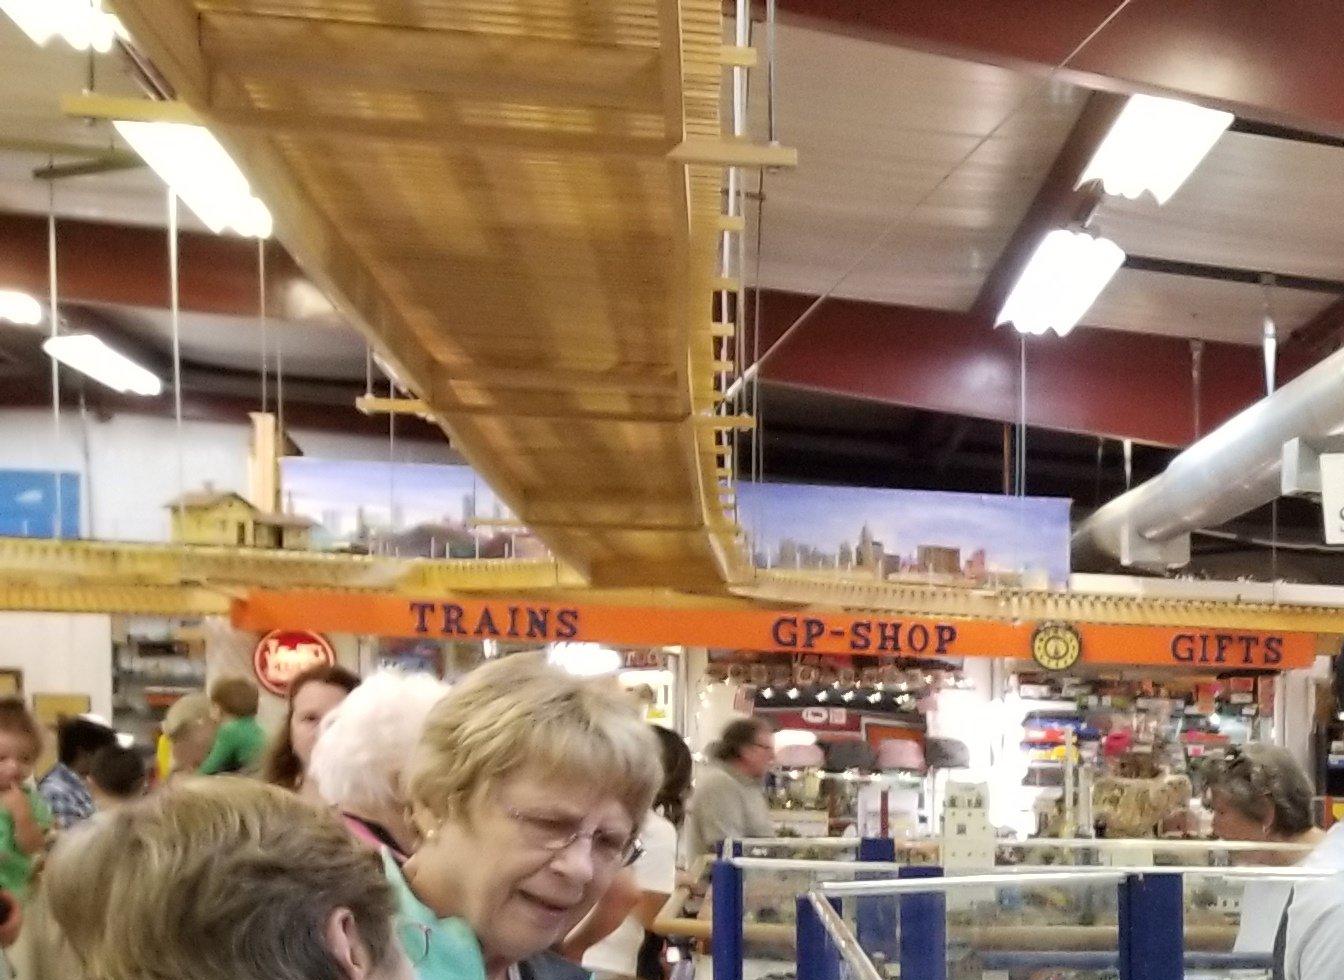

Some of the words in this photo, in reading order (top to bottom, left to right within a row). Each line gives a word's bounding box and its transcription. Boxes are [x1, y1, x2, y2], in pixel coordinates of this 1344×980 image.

[409, 601, 580, 639] TRAINS
[771, 616, 958, 655] GP-SHOP
[1171, 633, 1284, 664] GIFTS
